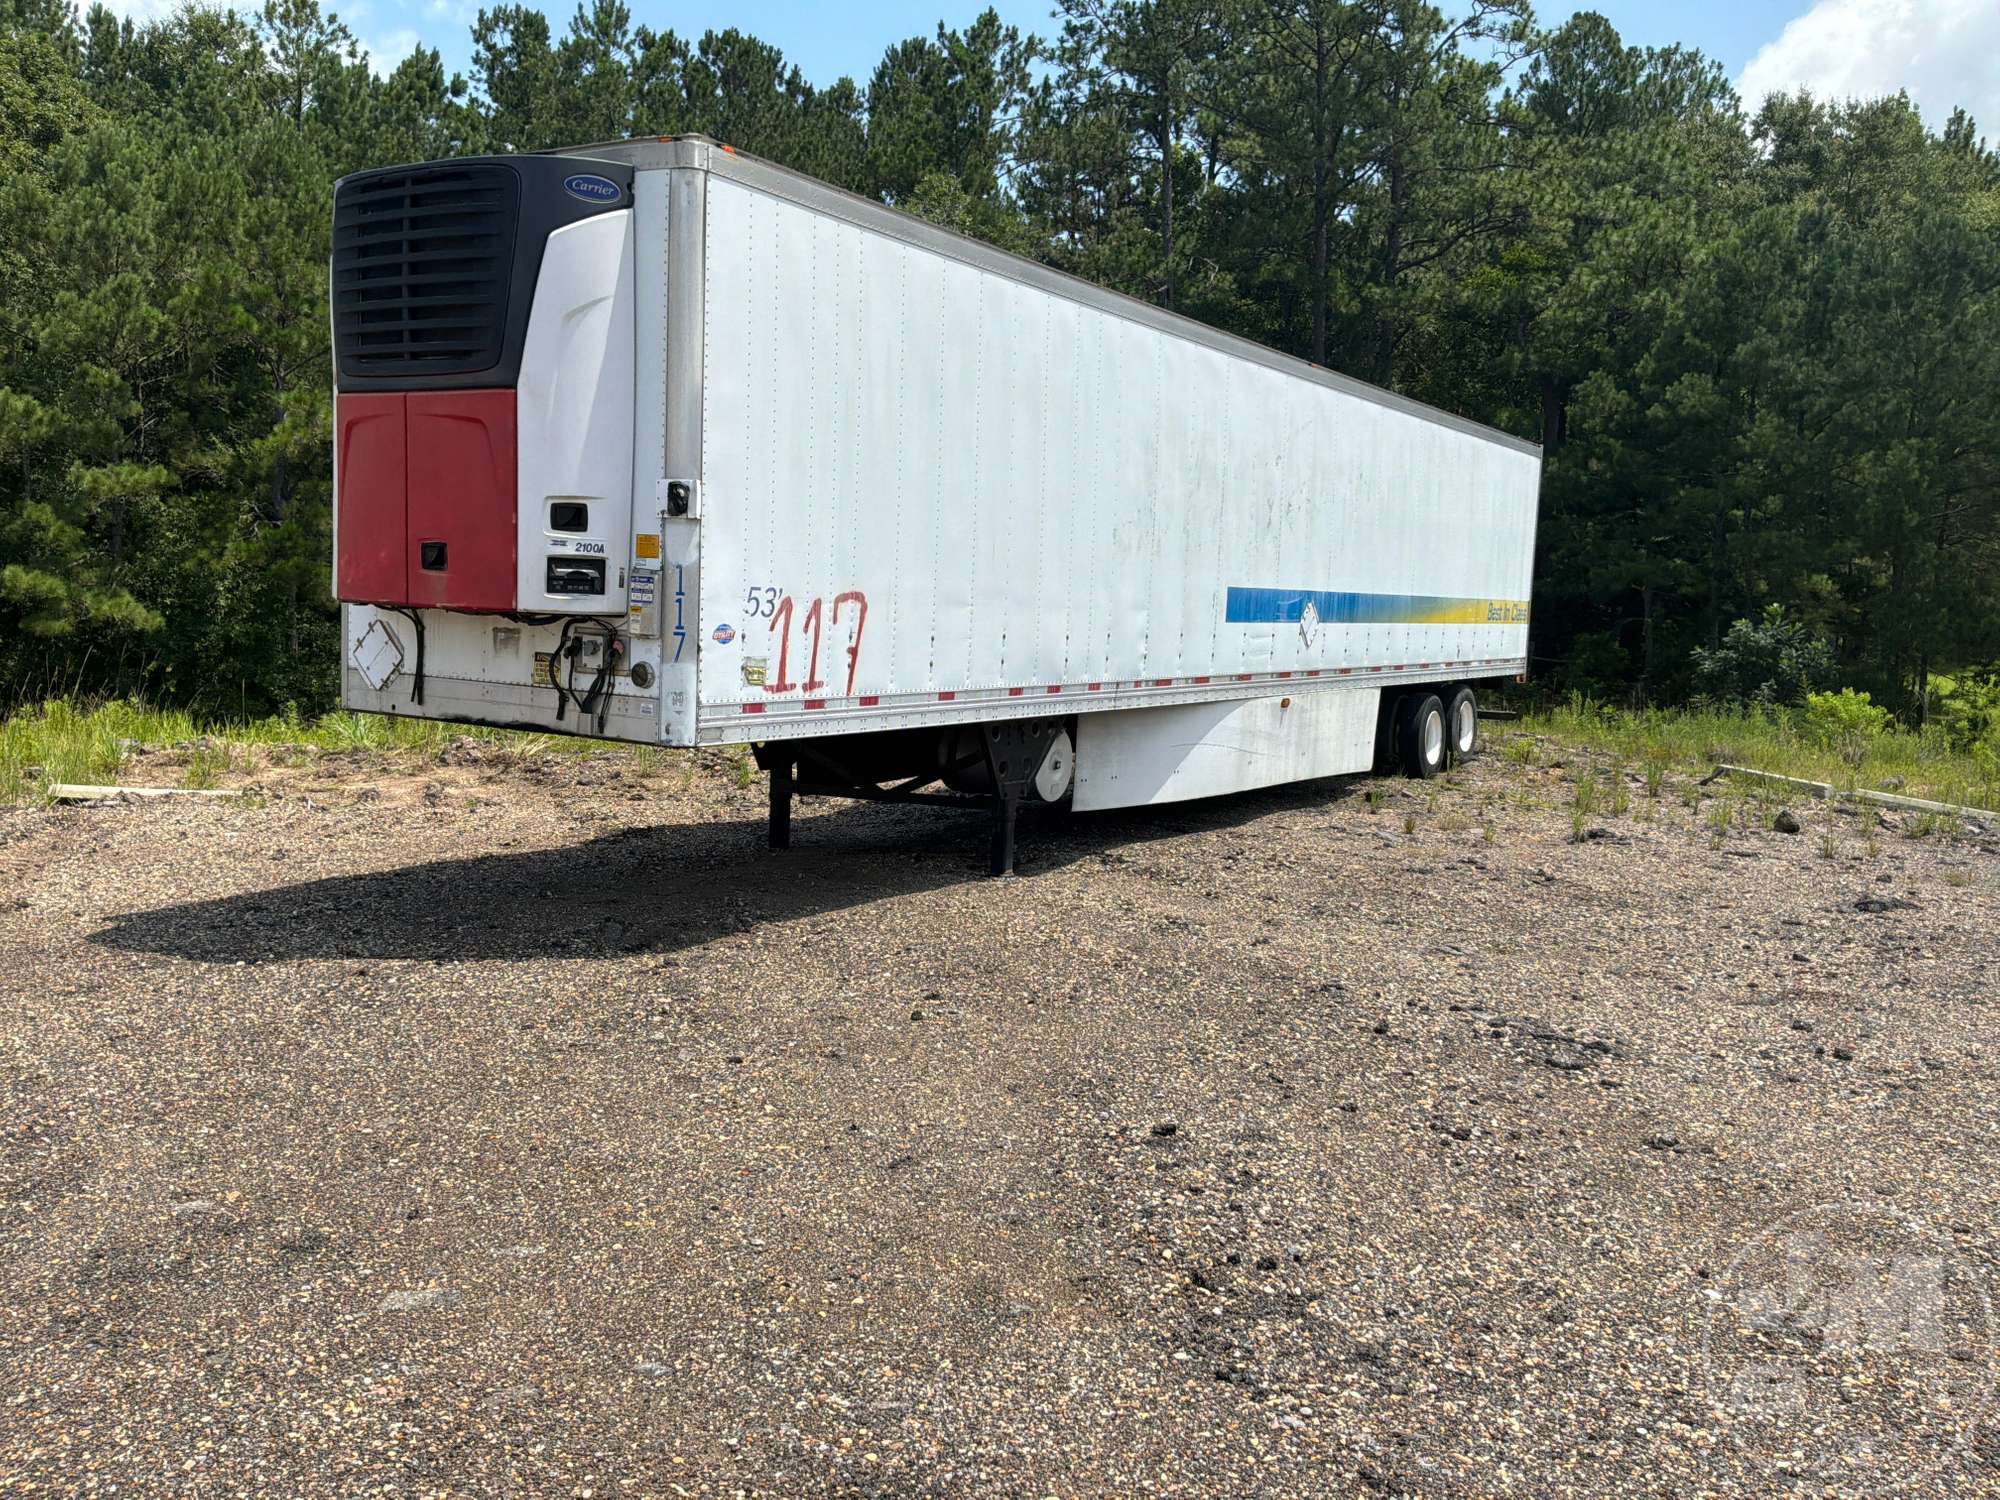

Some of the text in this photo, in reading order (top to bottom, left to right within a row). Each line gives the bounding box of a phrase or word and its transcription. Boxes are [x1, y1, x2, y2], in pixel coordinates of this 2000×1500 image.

[572, 180, 614, 195] Carrier
[575, 542, 605, 553] 2100A
[1488, 602, 1502, 621] Best
[763, 591, 868, 696] 117
